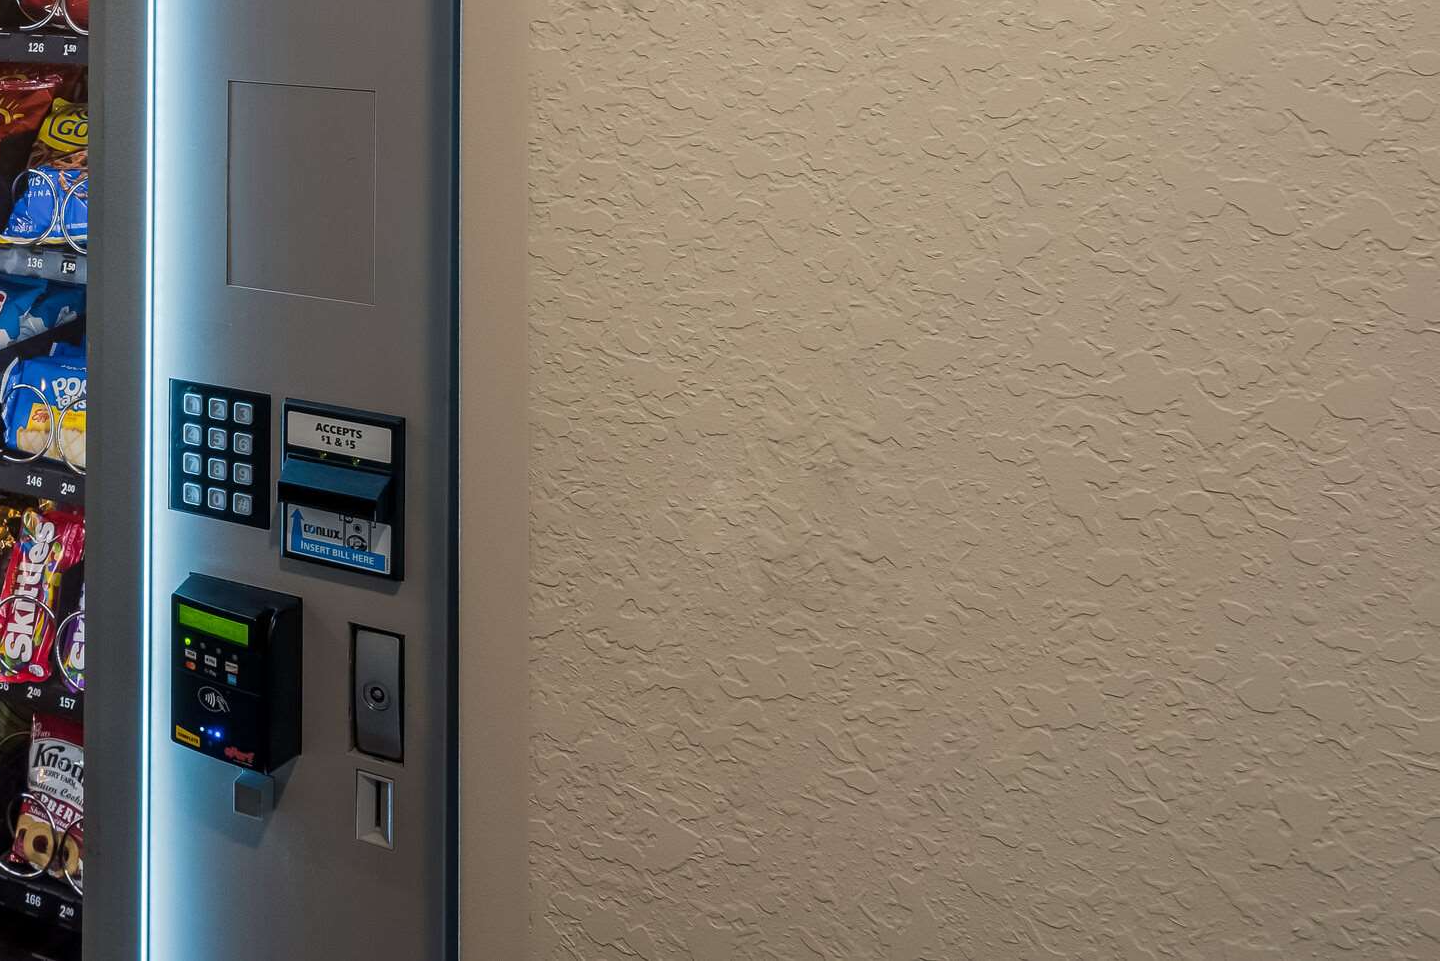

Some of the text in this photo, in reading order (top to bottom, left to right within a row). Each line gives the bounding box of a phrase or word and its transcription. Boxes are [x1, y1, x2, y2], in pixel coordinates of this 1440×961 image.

[28, 43, 44, 52] 126
[27, 258, 43, 268] 136
[316, 422, 363, 439] ACCEPTS
[335, 437, 342, 447] &
[345, 439, 356, 450] $5
[26, 475, 42, 487] 146
[300, 539, 375, 566] INSERT BILL HERE
[4, 521, 56, 664] Skittles
[60, 697, 75, 709] 157
[25, 892, 40, 906] 166
